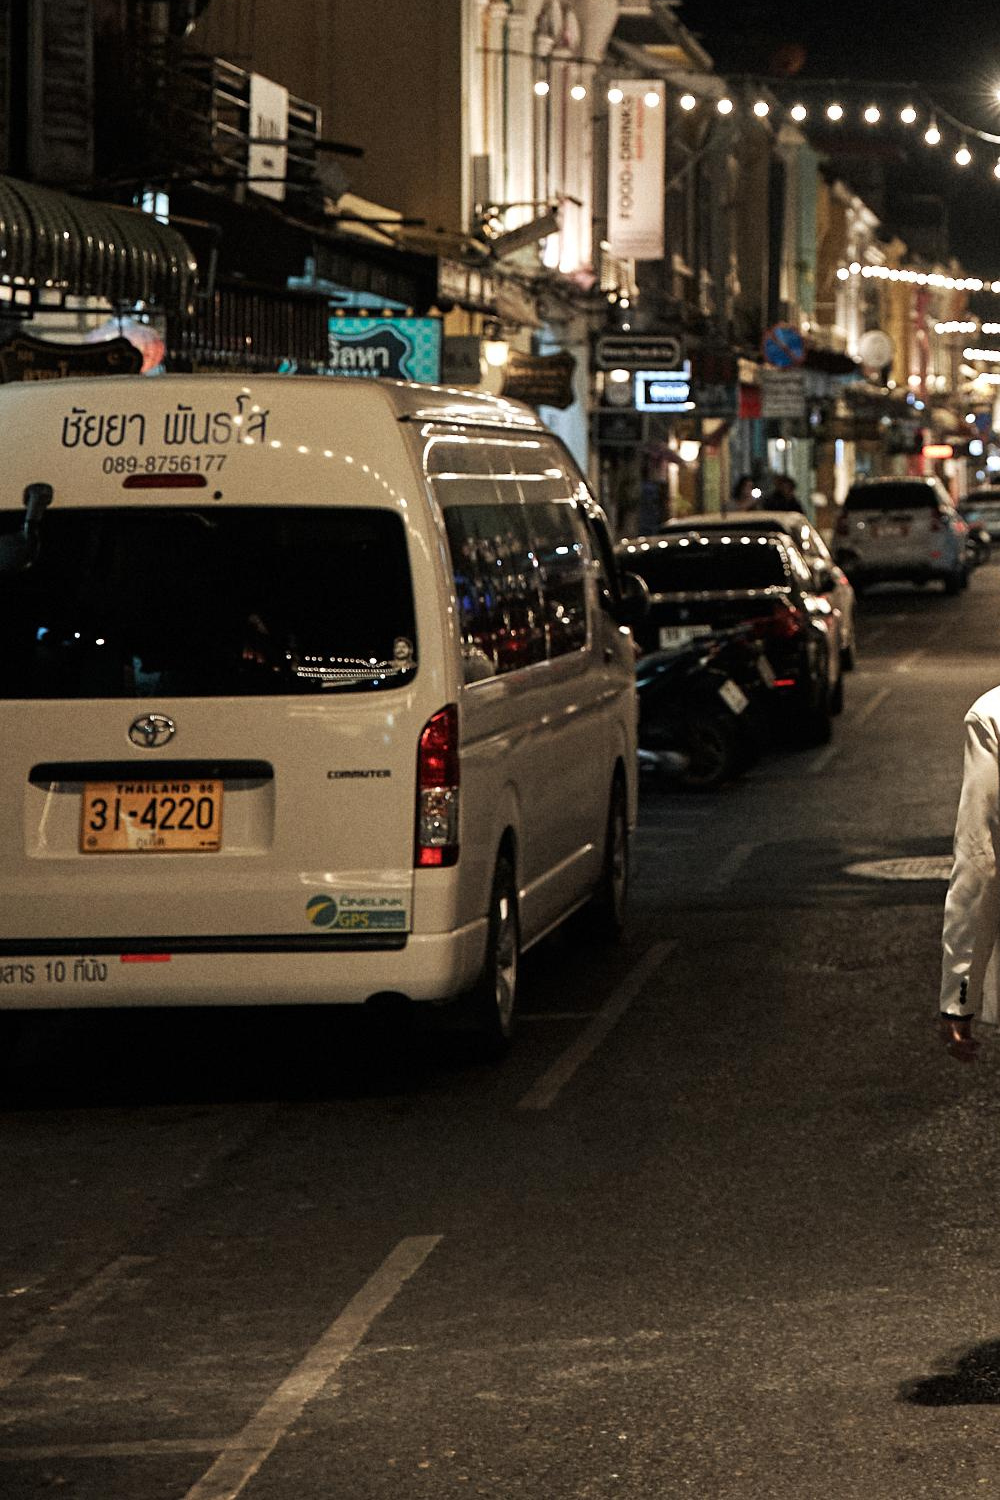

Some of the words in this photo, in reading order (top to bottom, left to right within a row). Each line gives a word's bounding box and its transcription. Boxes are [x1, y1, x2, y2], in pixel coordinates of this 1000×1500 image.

[61, 406, 146, 447] ชัยยา
[102, 454, 227, 474] 089-8756177
[117, 784, 191, 794] THAILAND
[90, 797, 214, 831] 31-4220
[340, 912, 369, 927] GPS
[47, 961, 66, 982] 10
